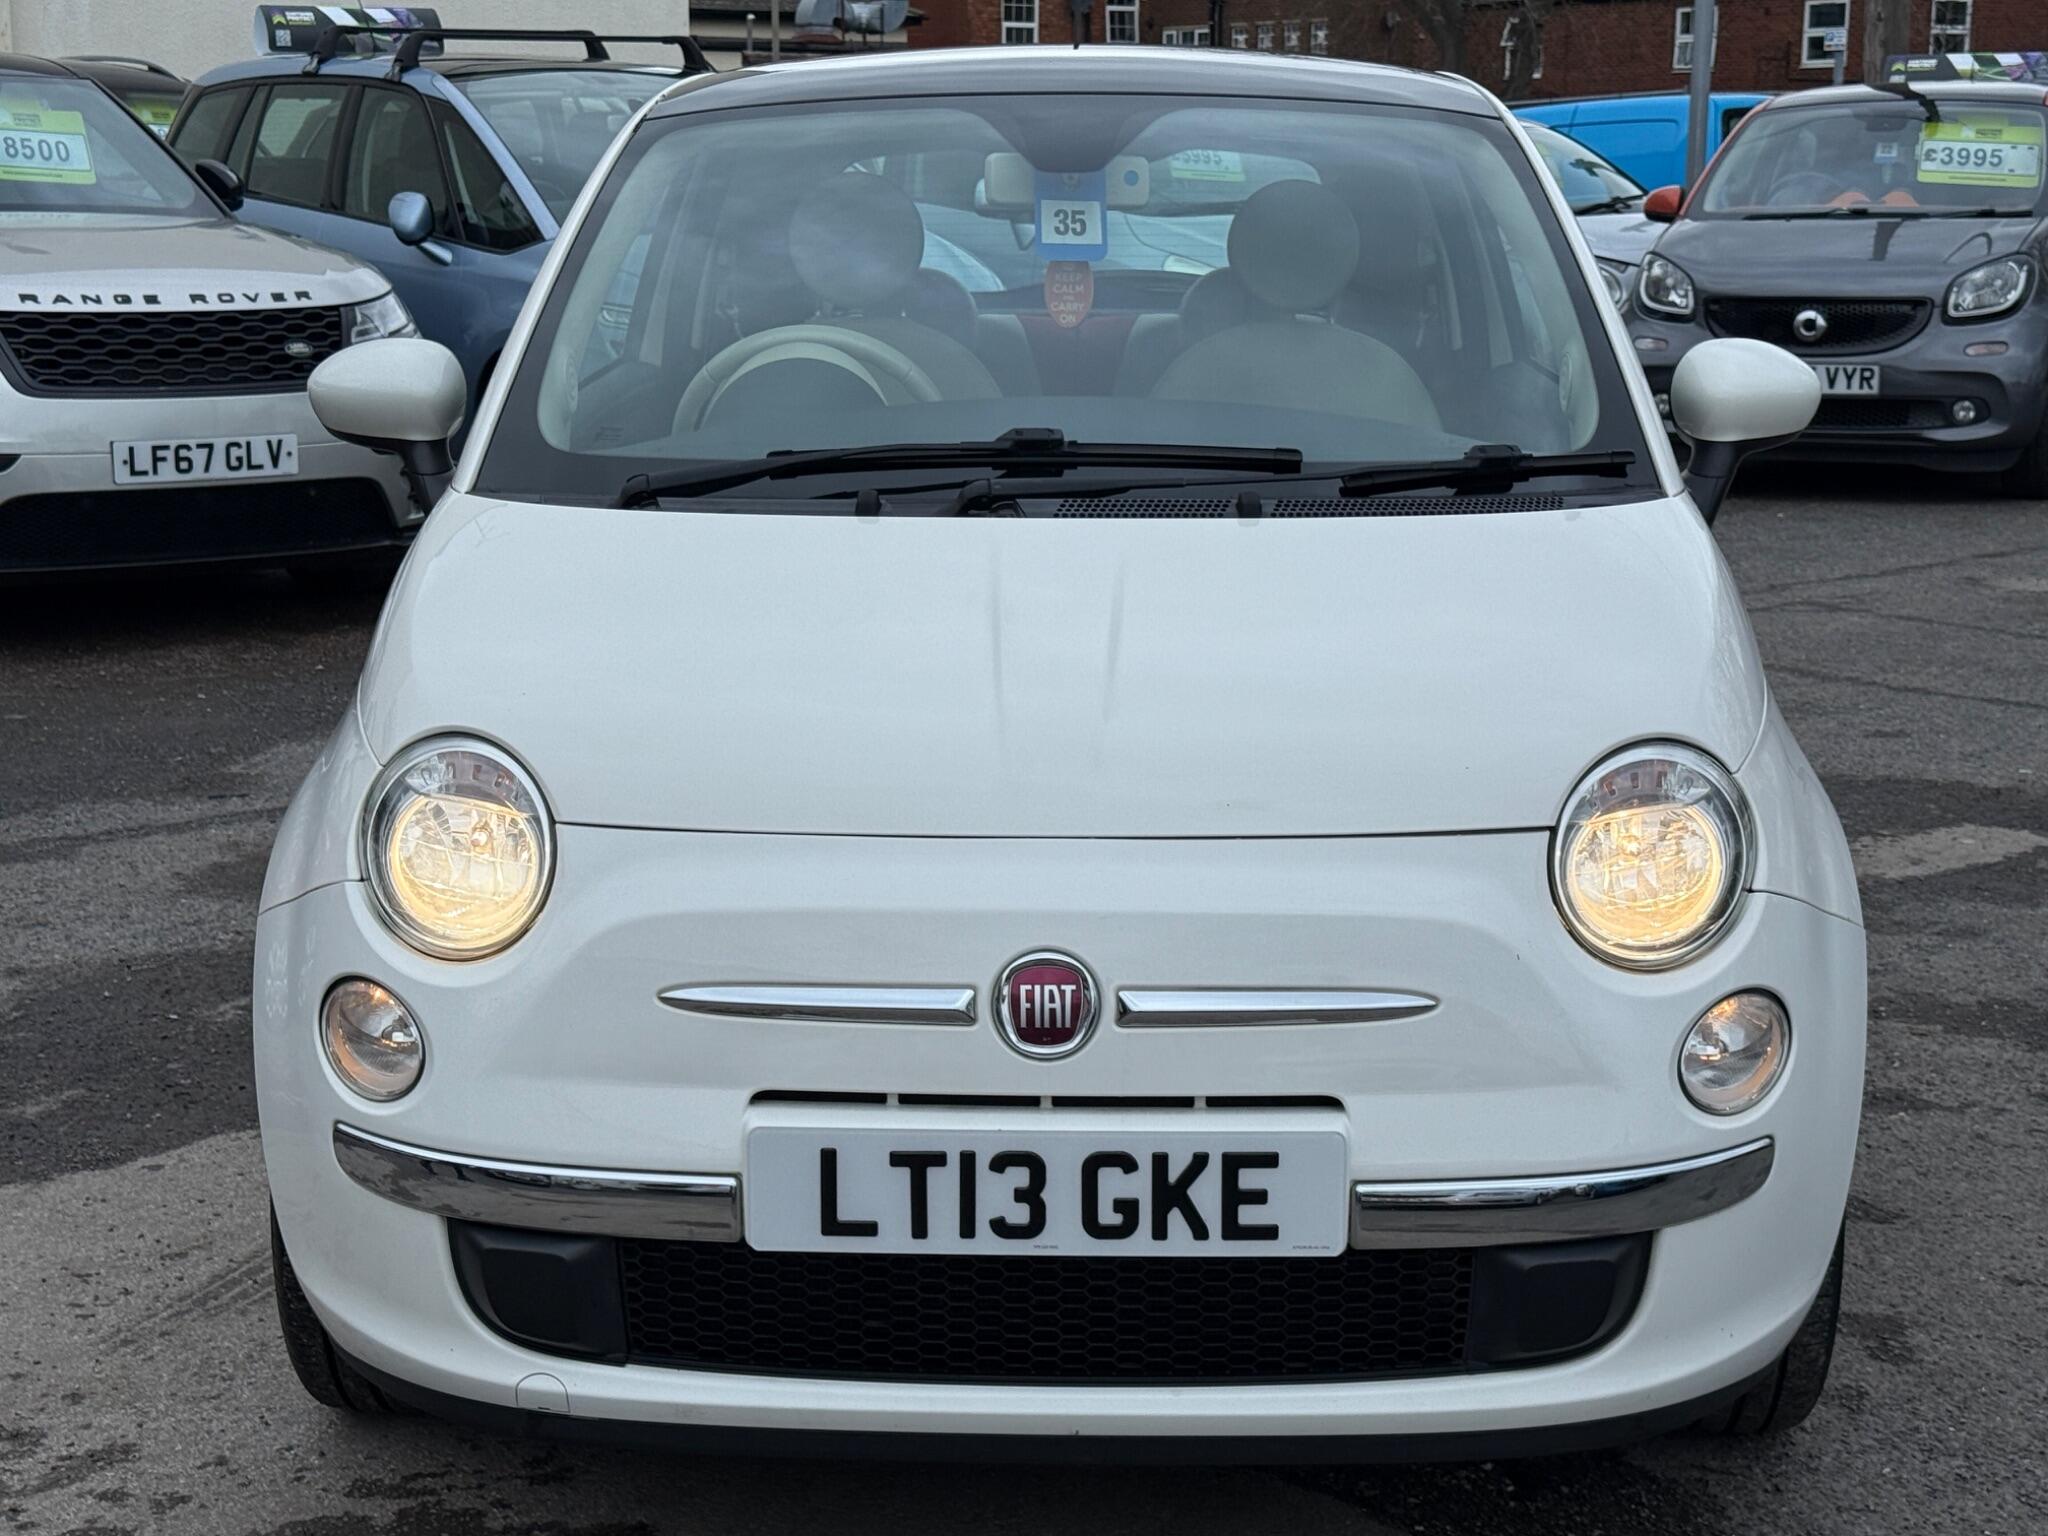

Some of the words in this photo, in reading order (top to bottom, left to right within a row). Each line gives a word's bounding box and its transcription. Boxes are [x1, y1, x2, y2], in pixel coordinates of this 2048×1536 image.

[1924, 146, 2004, 168] £3995
[1053, 208, 1087, 237] 35
[1055, 272, 1083, 282] KEEP
[18, 293, 162, 305] RANGE
[189, 290, 313, 304] ROVER
[1053, 283, 1085, 294] CALM
[1050, 302, 1085, 312] CARRY
[1059, 314, 1076, 323] ON
[1825, 366, 1875, 390] VYR
[128, 443, 214, 477] LF67
[225, 439, 283, 472] GLV
[1019, 984, 1077, 1029] FIAT
[820, 1147, 1047, 1240] LT13
[1081, 1150, 1280, 1242] GKE
